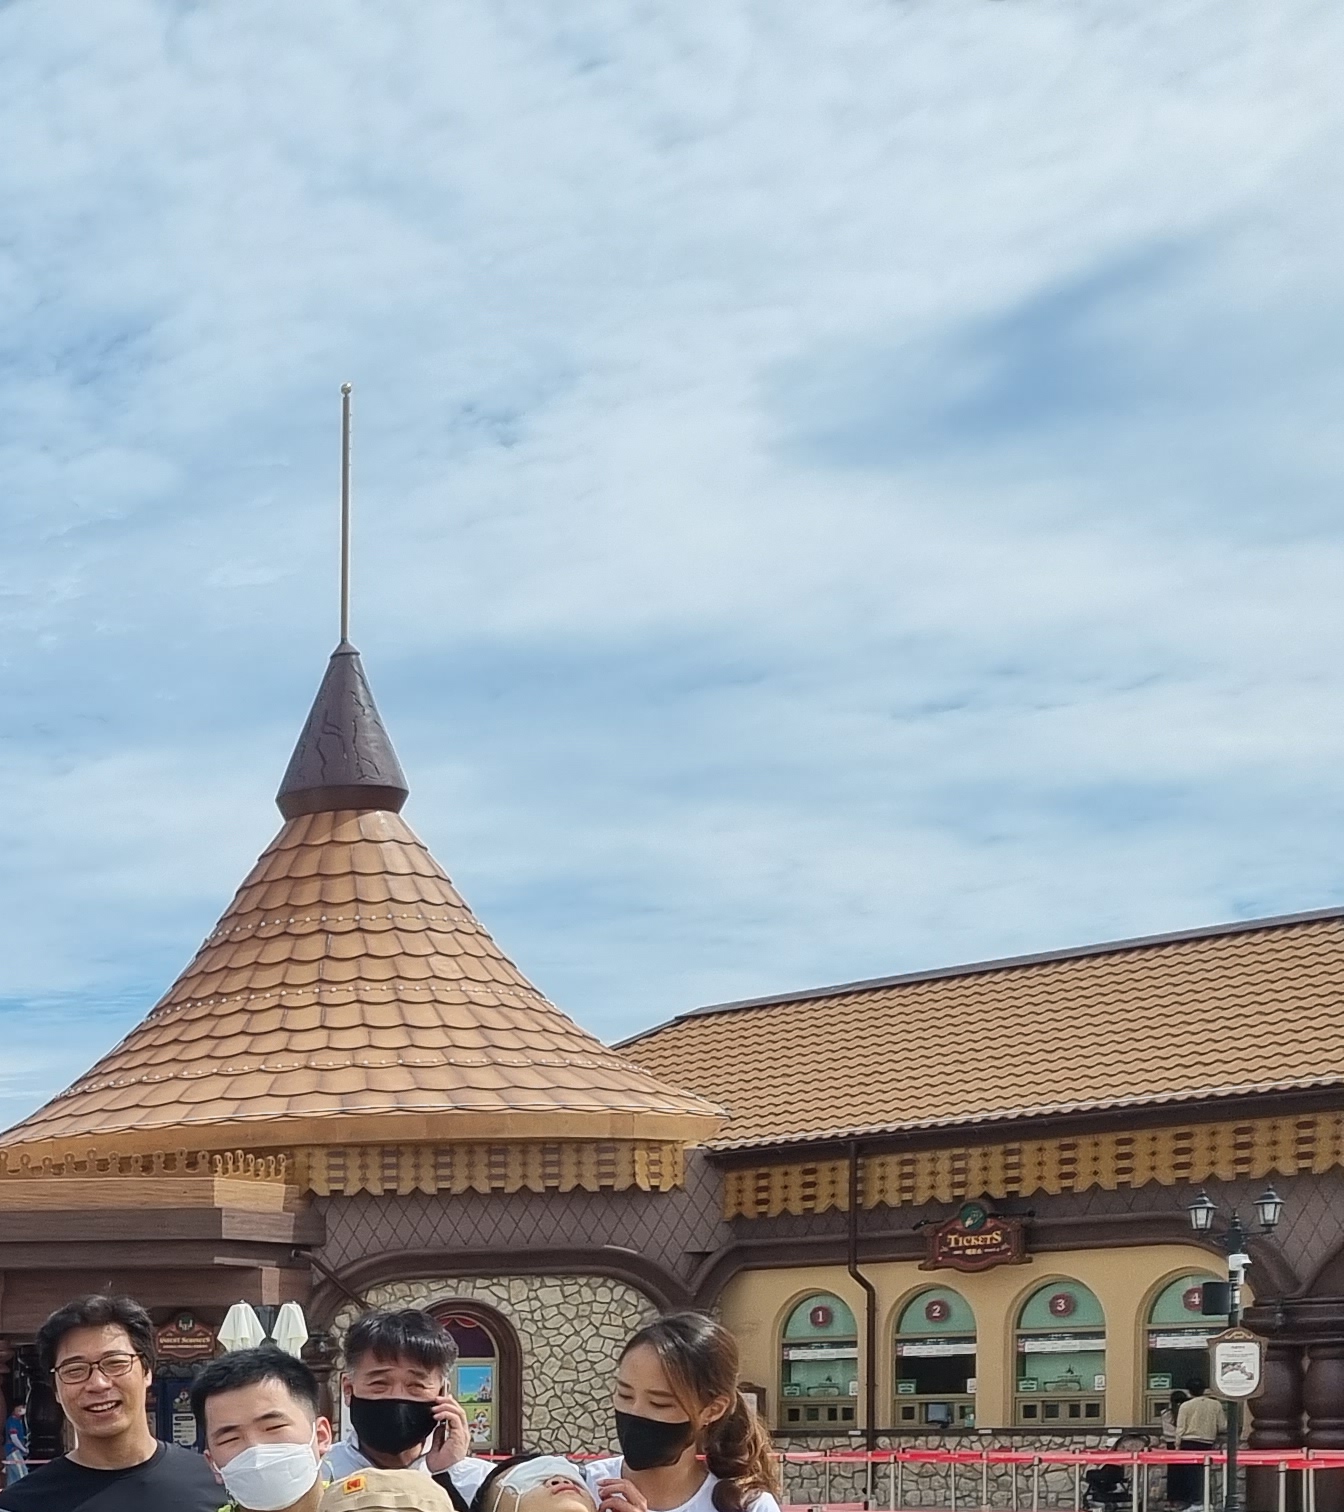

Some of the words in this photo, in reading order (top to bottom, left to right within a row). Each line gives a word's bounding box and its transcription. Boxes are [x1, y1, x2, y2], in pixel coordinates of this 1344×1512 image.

[947, 1230, 1002, 1248] TICKETS
[1191, 1292, 1200, 1304] 4
[1056, 1299, 1066, 1311] 3
[817, 1311, 824, 1323] 1
[932, 1306, 941, 1317] 2
